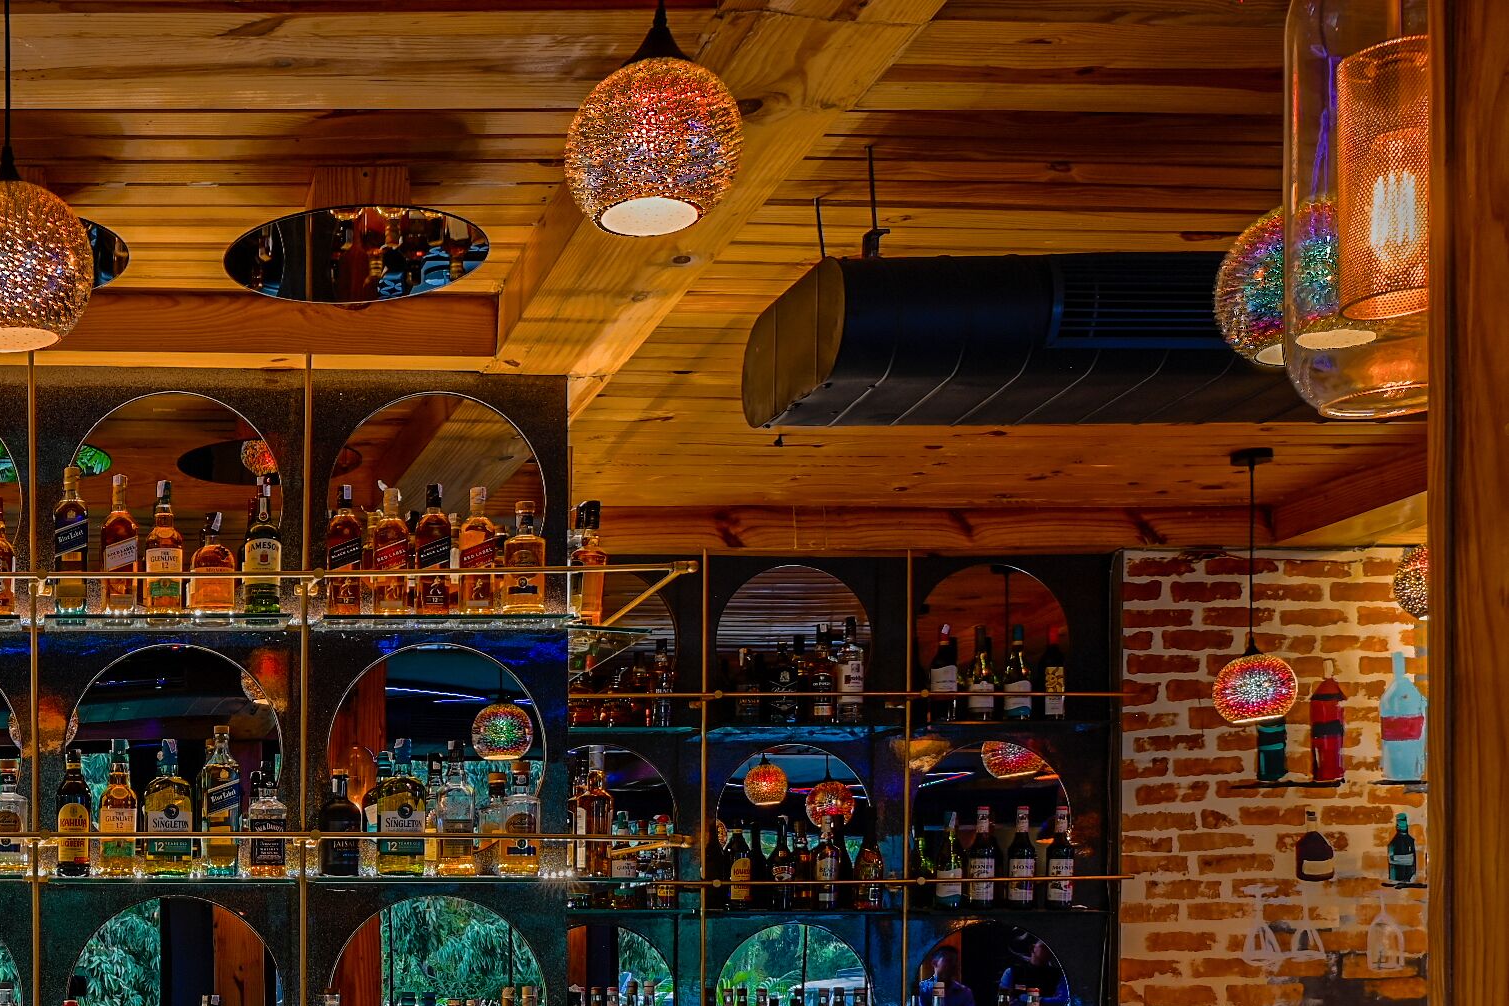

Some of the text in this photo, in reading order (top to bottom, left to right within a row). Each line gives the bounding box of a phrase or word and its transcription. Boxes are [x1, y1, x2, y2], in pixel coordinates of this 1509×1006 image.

[58, 534, 70, 543] Blue
[70, 529, 84, 540] Label
[248, 541, 280, 553] JAMESON
[388, 549, 407, 558] LABEL
[475, 548, 493, 557] LABEL
[211, 790, 236, 803] Blue Label
[152, 818, 189, 828] SINGLETON
[385, 818, 422, 828] SINGLETON
[154, 842, 165, 852] 12
[387, 841, 398, 851] 12
